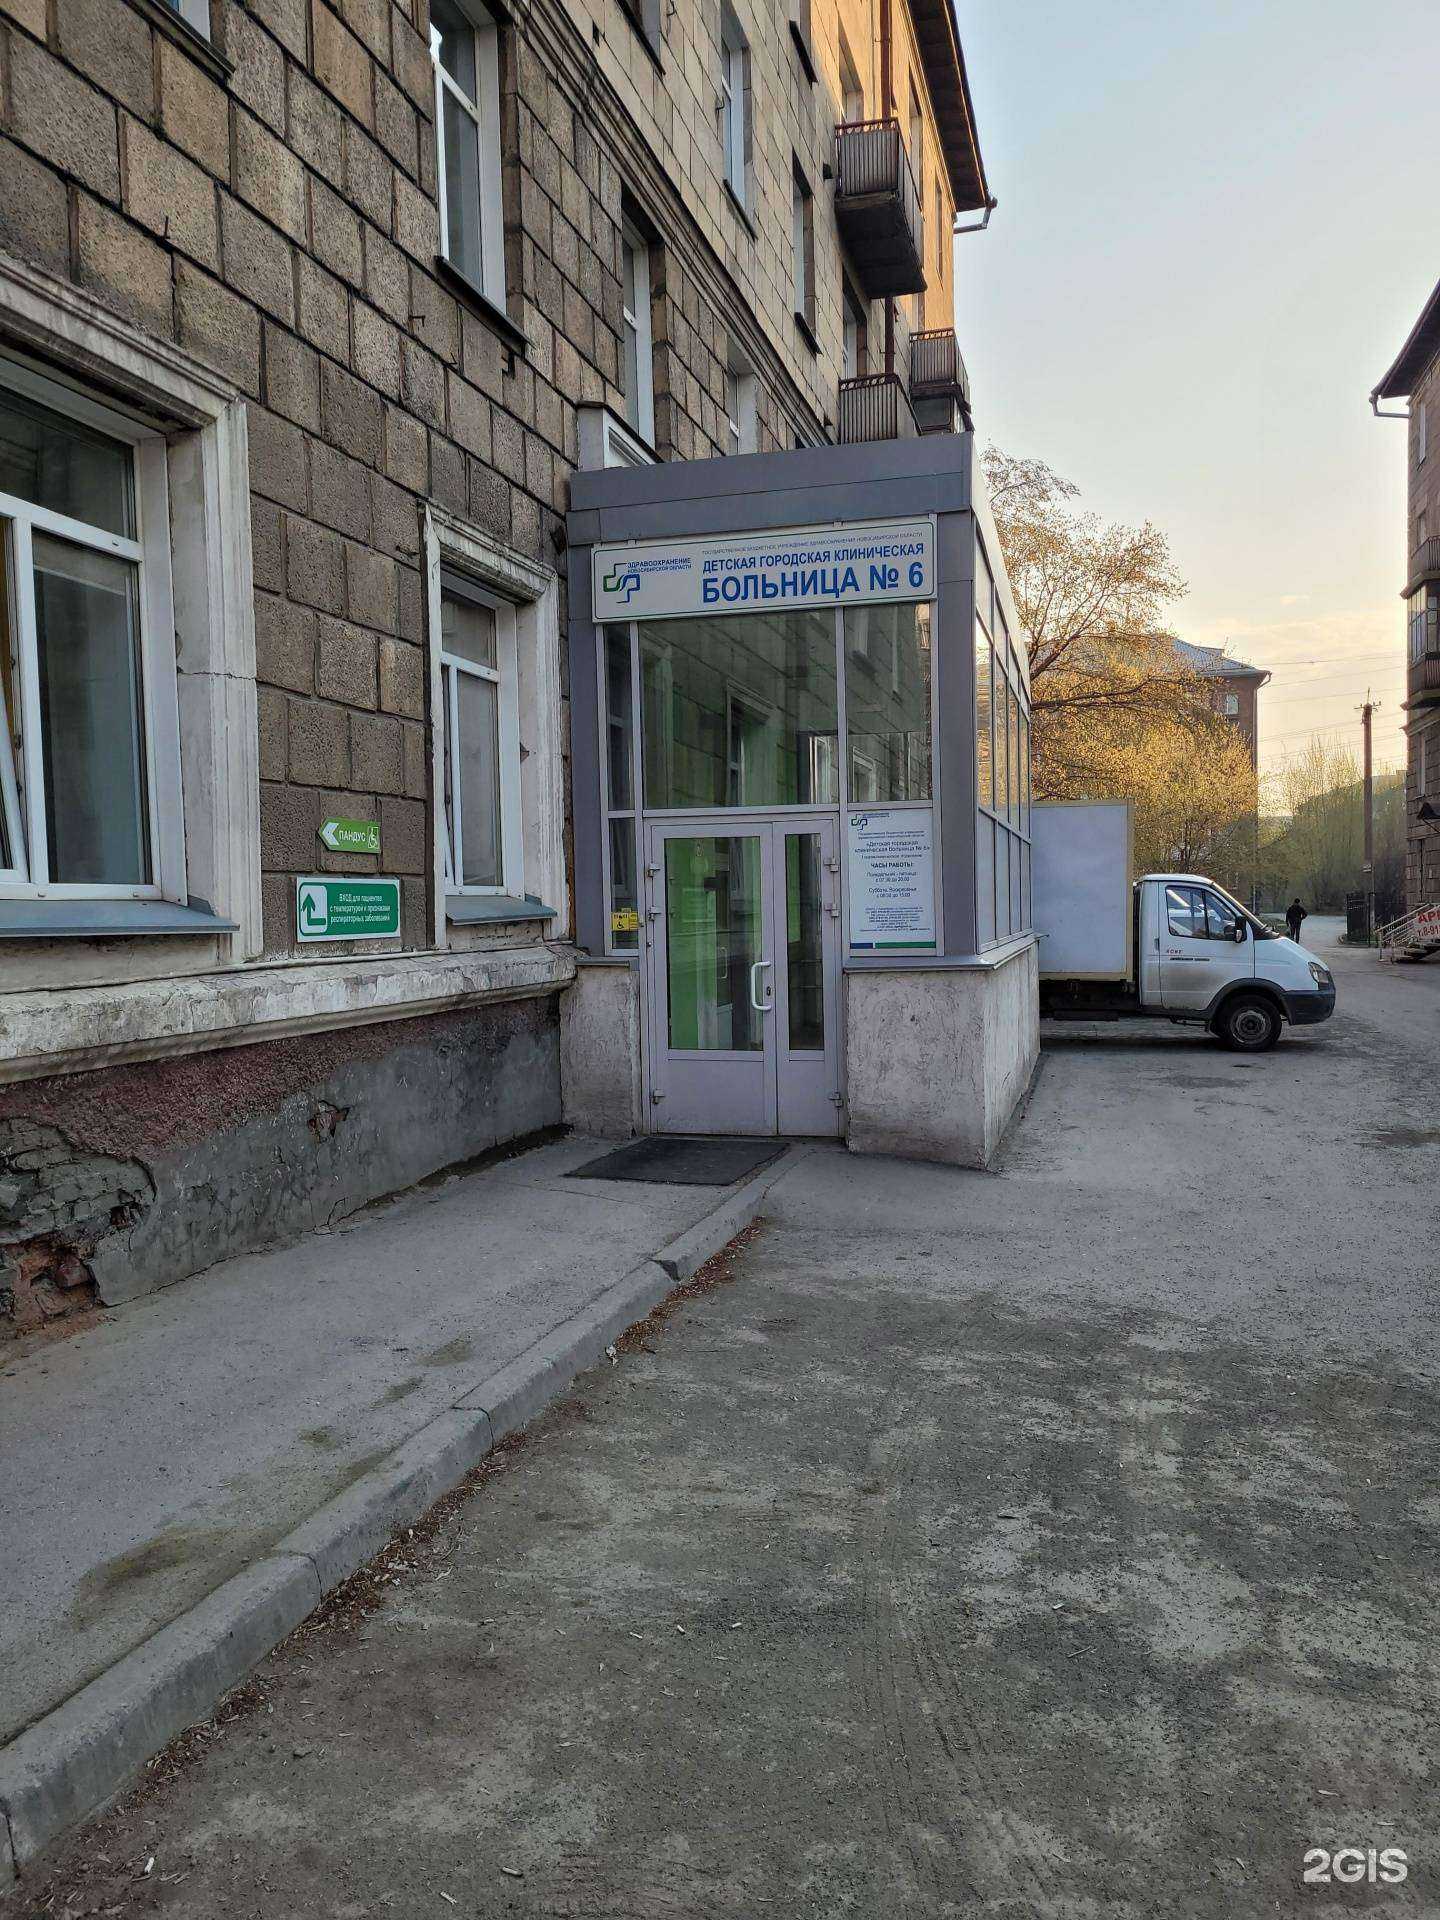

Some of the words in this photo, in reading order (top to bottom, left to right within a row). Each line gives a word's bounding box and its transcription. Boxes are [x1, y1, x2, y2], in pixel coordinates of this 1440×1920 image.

[627, 557, 691, 569] ЗДРАВООХРАНЕНИЕ
[703, 557, 756, 574] ДЕТСКАЯ
[760, 550, 830, 568] ГОРОДСКАЯ
[834, 543, 924, 562] КЛИНИЧЕСКАЯ
[702, 566, 860, 603] БОЛЬНИЦА
[869, 564, 899, 591] №
[908, 561, 924, 588] 6
[339, 830, 366, 843] ПАНДУС
